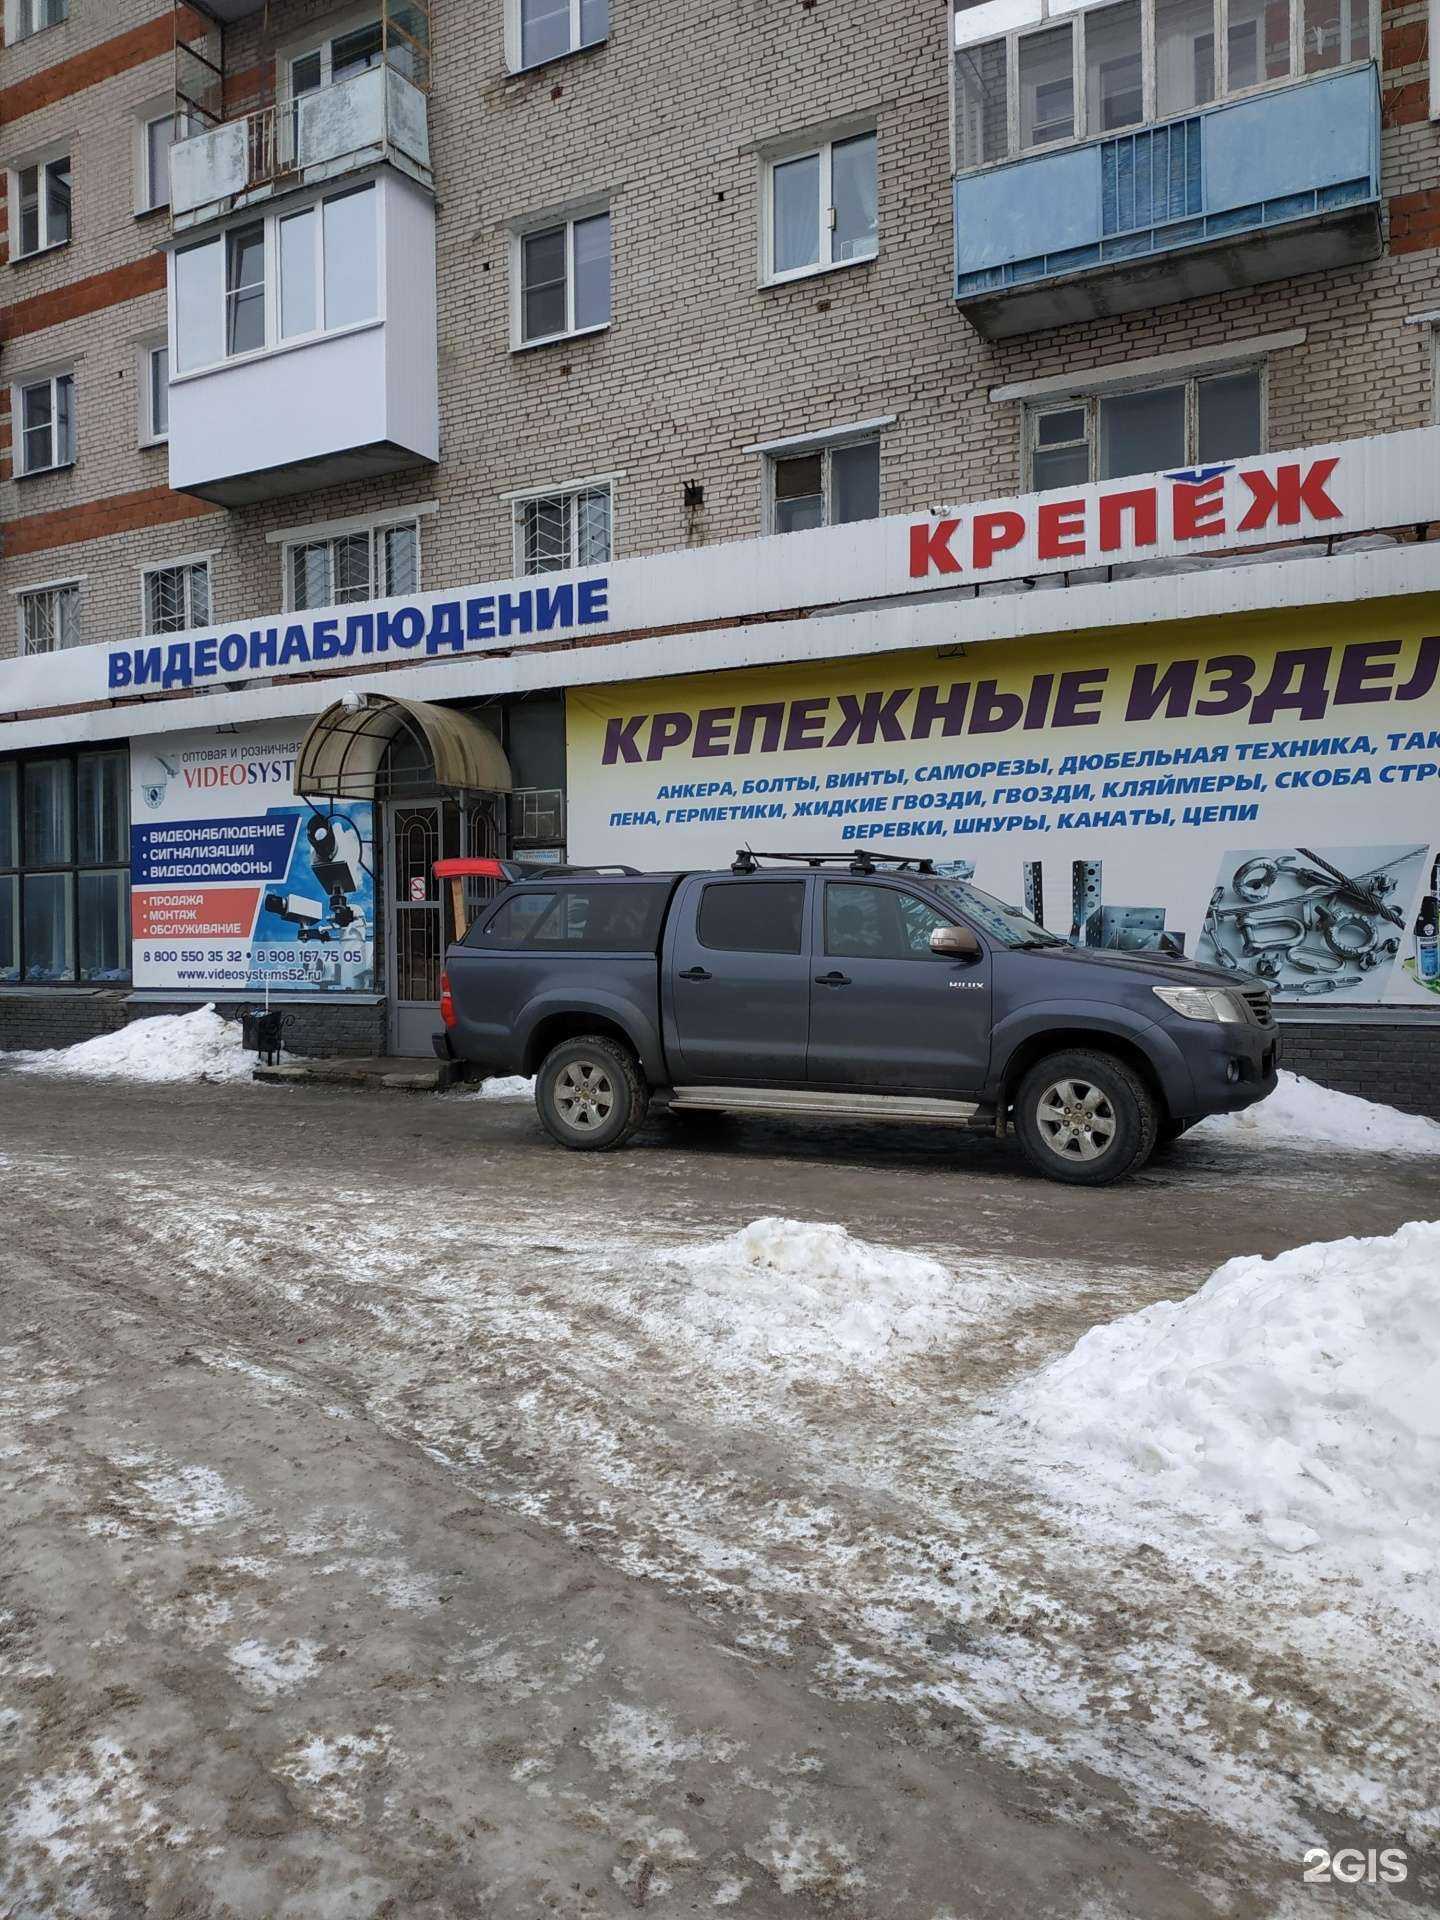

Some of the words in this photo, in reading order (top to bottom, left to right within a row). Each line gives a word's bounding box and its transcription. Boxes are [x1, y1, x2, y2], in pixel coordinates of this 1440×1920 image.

[107, 577, 609, 690] ВИДЕОНАБЛЮДЕНИЕ
[601, 668, 1110, 766] КРЕПЕЖНЫЕ
[182, 749, 227, 763] оптовая
[657, 779, 739, 800] АНКЕРА,
[741, 773, 820, 796] БОЛТЫ,
[825, 767, 909, 790] ВИНТЫ,
[913, 756, 1054, 783] САМОРЕЗЫ,
[1059, 744, 1230, 776] ДЮБЕЛЬНАЯ
[1234, 733, 1379, 762] ТЕХНИКА,
[609, 810, 663, 828] ПЕНА,
[665, 800, 787, 824] ГЕРМЕТИКИ,
[792, 796, 888, 818] ЖИДКИЕ
[890, 788, 987, 812] ГВОЗДИ,
[993, 782, 1097, 806] ГВОЗДИ,
[1101, 772, 1269, 800] КЛЯЙМЕРЫ,
[1274, 766, 1373, 789] СКОБА
[1379, 762, 1440, 783] СТР
[842, 818, 949, 840] ВЕРЕВКИ,
[953, 812, 1052, 834] ШНУРЫ,
[1057, 806, 1177, 830] КАНАТЫ,
[1182, 803, 1259, 826] ЦЕПИ
[150, 824, 286, 843] ВИДЕОНАБЛЮДЕНИЕ
[150, 844, 254, 861] СИГНАЛИЗАЦИИ
[150, 861, 272, 878] ВИДЕОДОМОФОНЫ
[149, 894, 204, 907] ПРОДАЖА
[149, 910, 197, 921] МОНТАЖ
[150, 923, 241, 935] ОБСЛУЖИВАНИЕ
[143, 951, 151, 962] 8
[154, 950, 178, 962] 800
[181, 950, 204, 962] 550
[207, 950, 223, 962] 35
[226, 950, 242, 962] 32
[257, 951, 265, 962] 8
[269, 950, 295, 962] 908
[299, 950, 319, 962] 167
[323, 950, 339, 962] 75
[343, 950, 362, 962] 05
